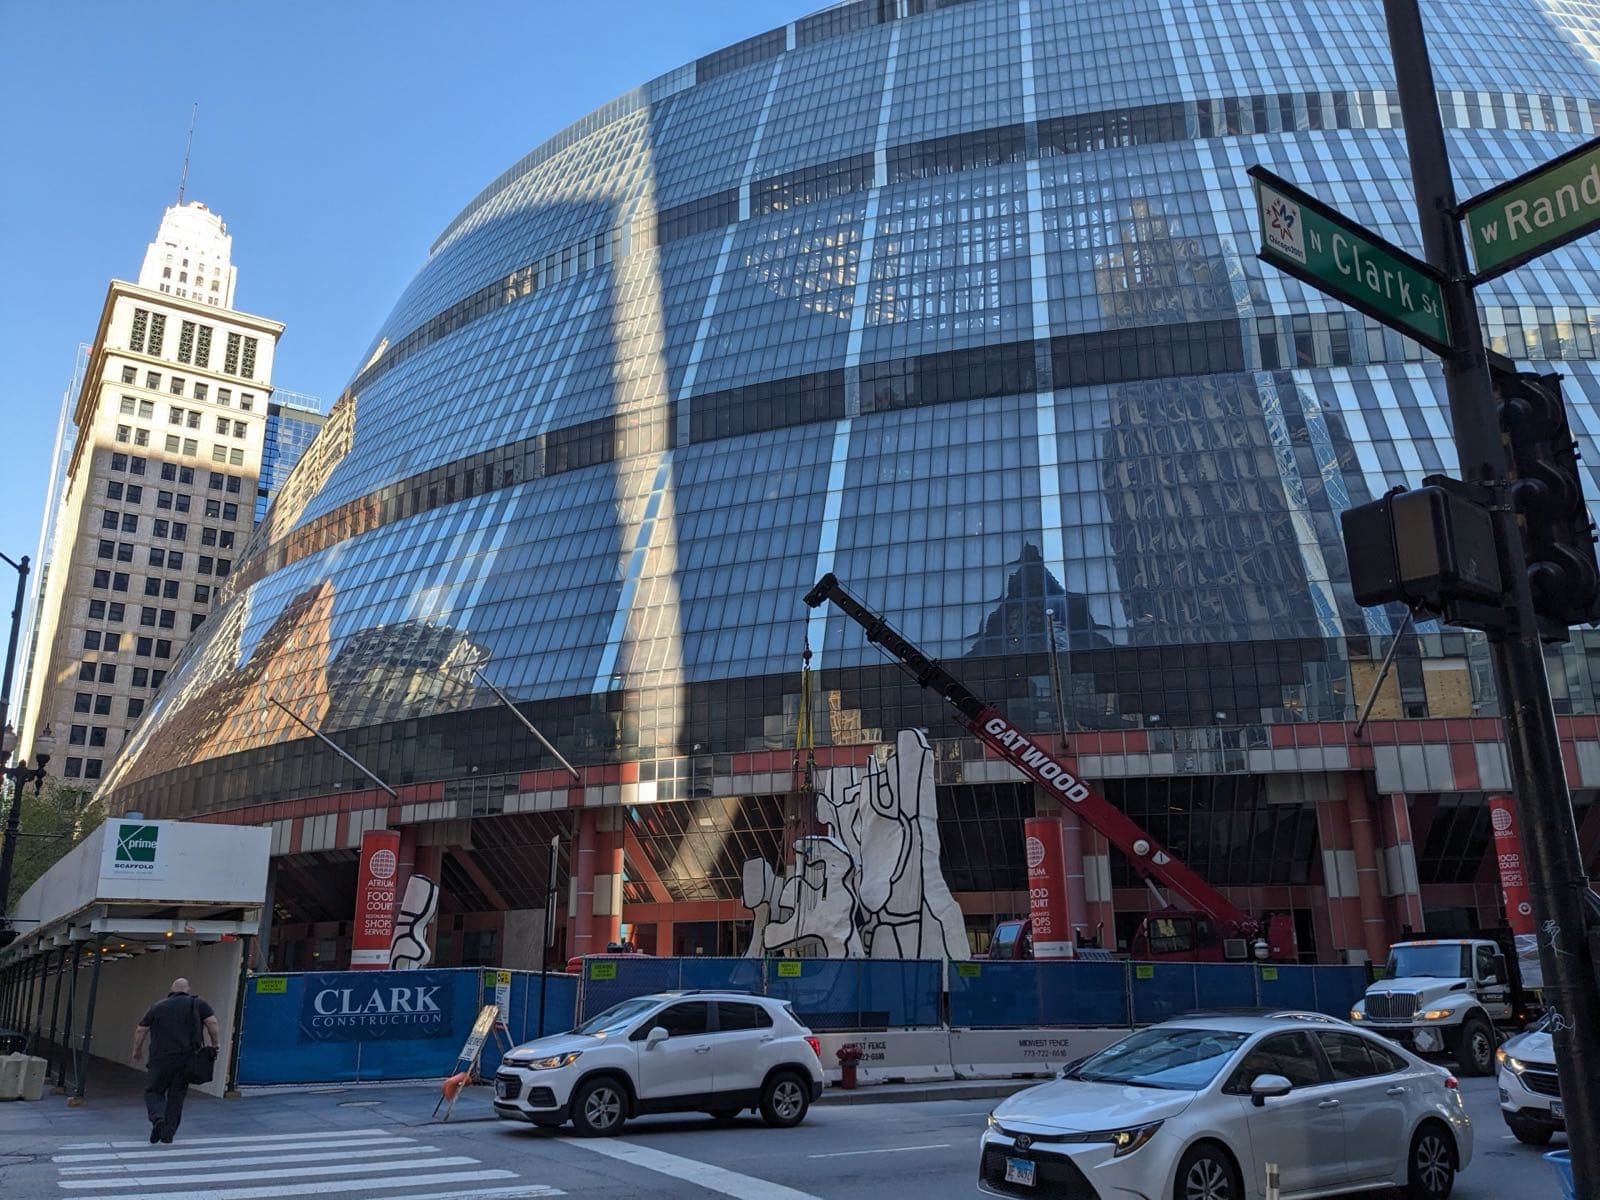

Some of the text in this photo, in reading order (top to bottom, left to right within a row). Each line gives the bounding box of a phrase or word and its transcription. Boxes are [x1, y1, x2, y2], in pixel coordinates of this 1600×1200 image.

[1480, 220, 1498, 244] W
[1309, 229, 1440, 319] N Clark St
[984, 718, 1090, 803] GATWOOD
[128, 838, 158, 850] prime
[367, 879, 394, 888] ATRIUM
[367, 891, 394, 902] FOOD
[366, 902, 393, 911] COURT
[364, 919, 392, 929] SHOPS
[314, 985, 442, 1015] CLARK
[312, 1014, 442, 1028] CONSTRUCTION
